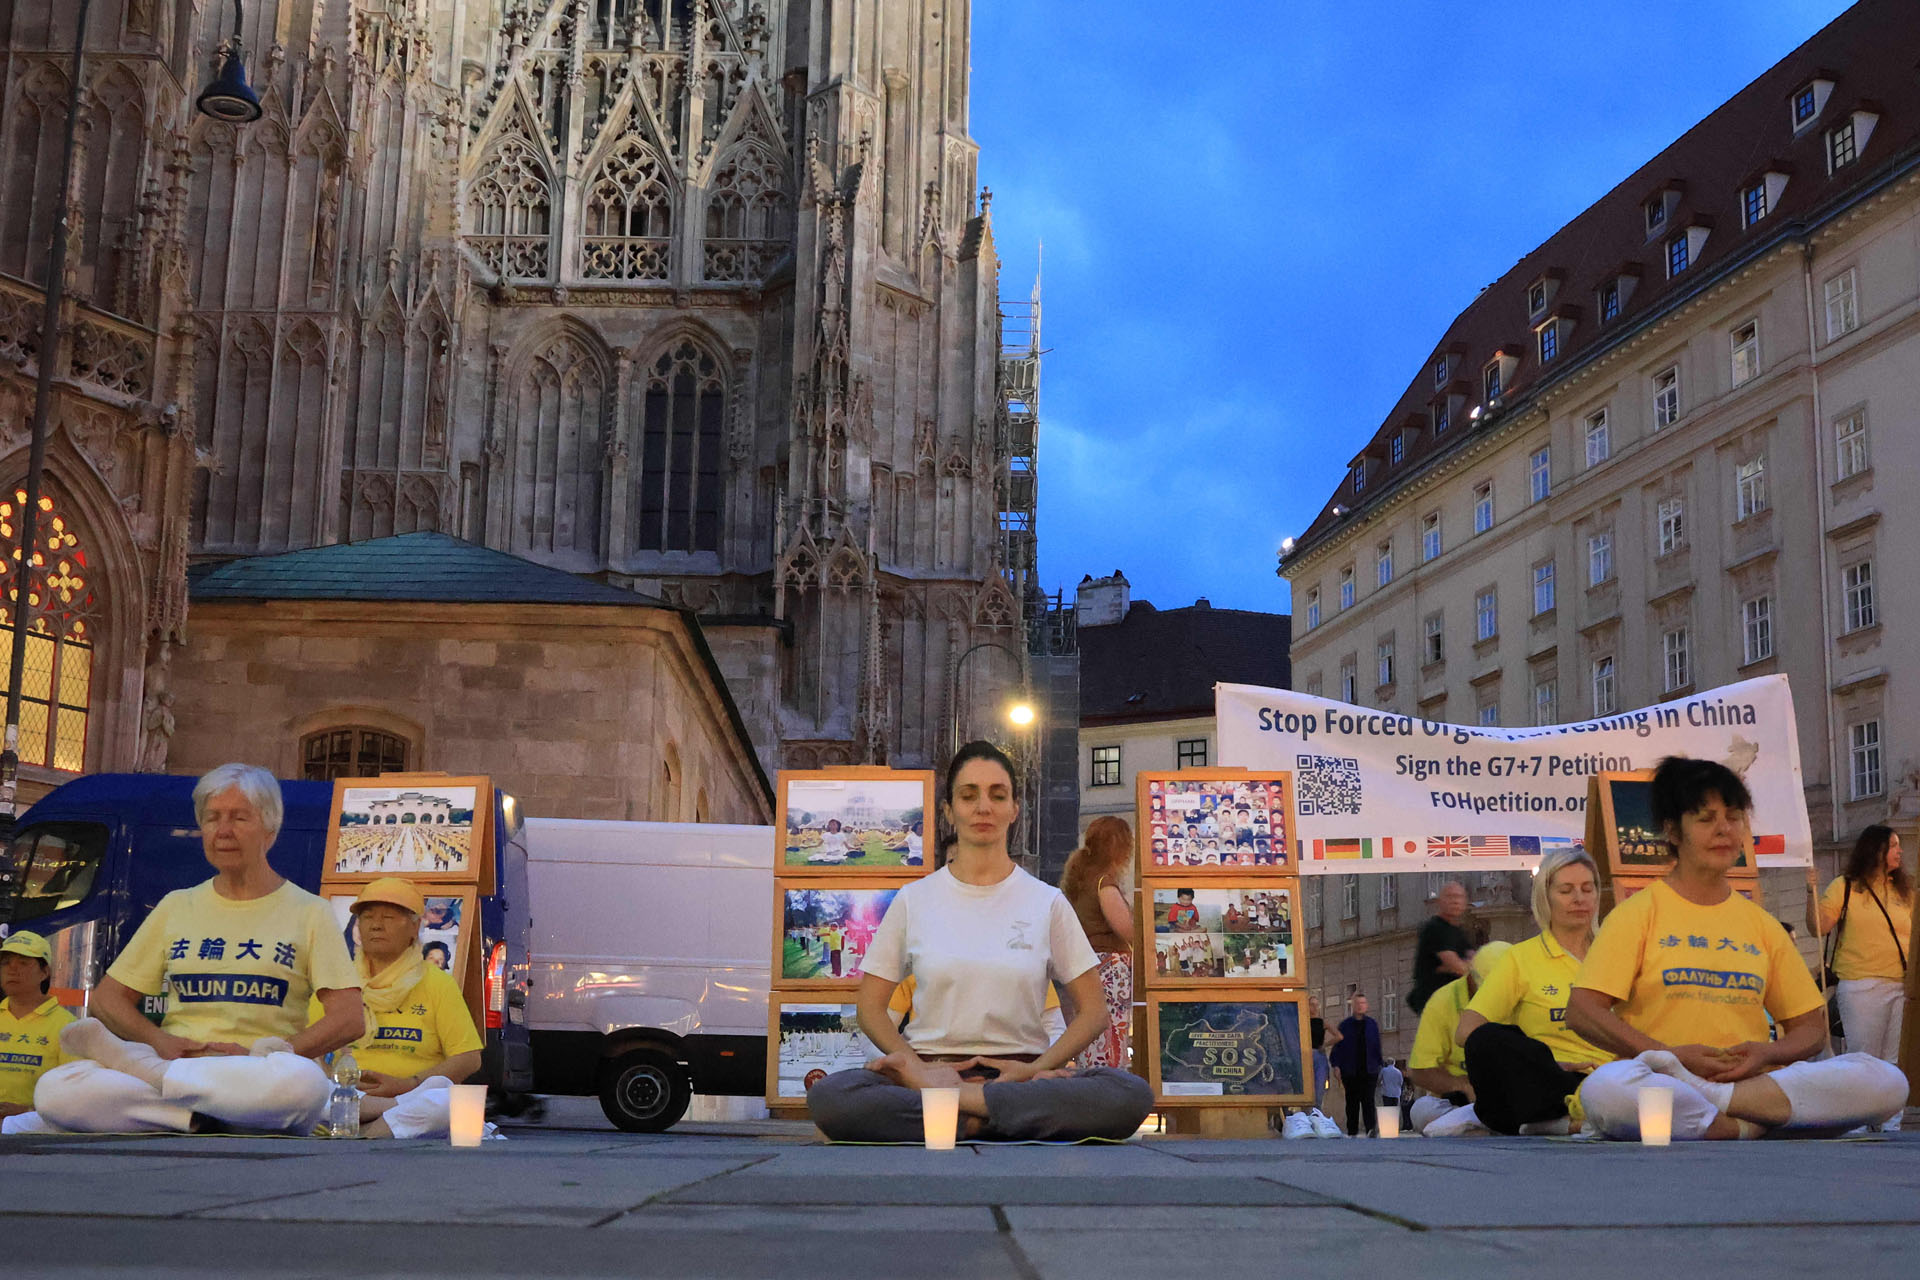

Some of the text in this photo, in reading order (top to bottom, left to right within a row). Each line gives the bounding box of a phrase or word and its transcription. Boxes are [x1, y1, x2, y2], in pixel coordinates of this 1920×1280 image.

[1258, 707, 1317, 741] Stop
[1325, 709, 1413, 736] Forced
[1654, 707, 1680, 728] in
[1687, 698, 1756, 727] China
[1395, 751, 1631, 782] Sign the G7+7 Petition
[1430, 791, 1588, 815] FOHpetition.or
[1665, 970, 1723, 986] ФАЛУНЬ
[232, 980, 279, 1000] DAFA
[383, 1028, 419, 1040] DAFA
[1203, 1047, 1257, 1066] SOS
[1223, 1066, 1242, 1074] CHINA
